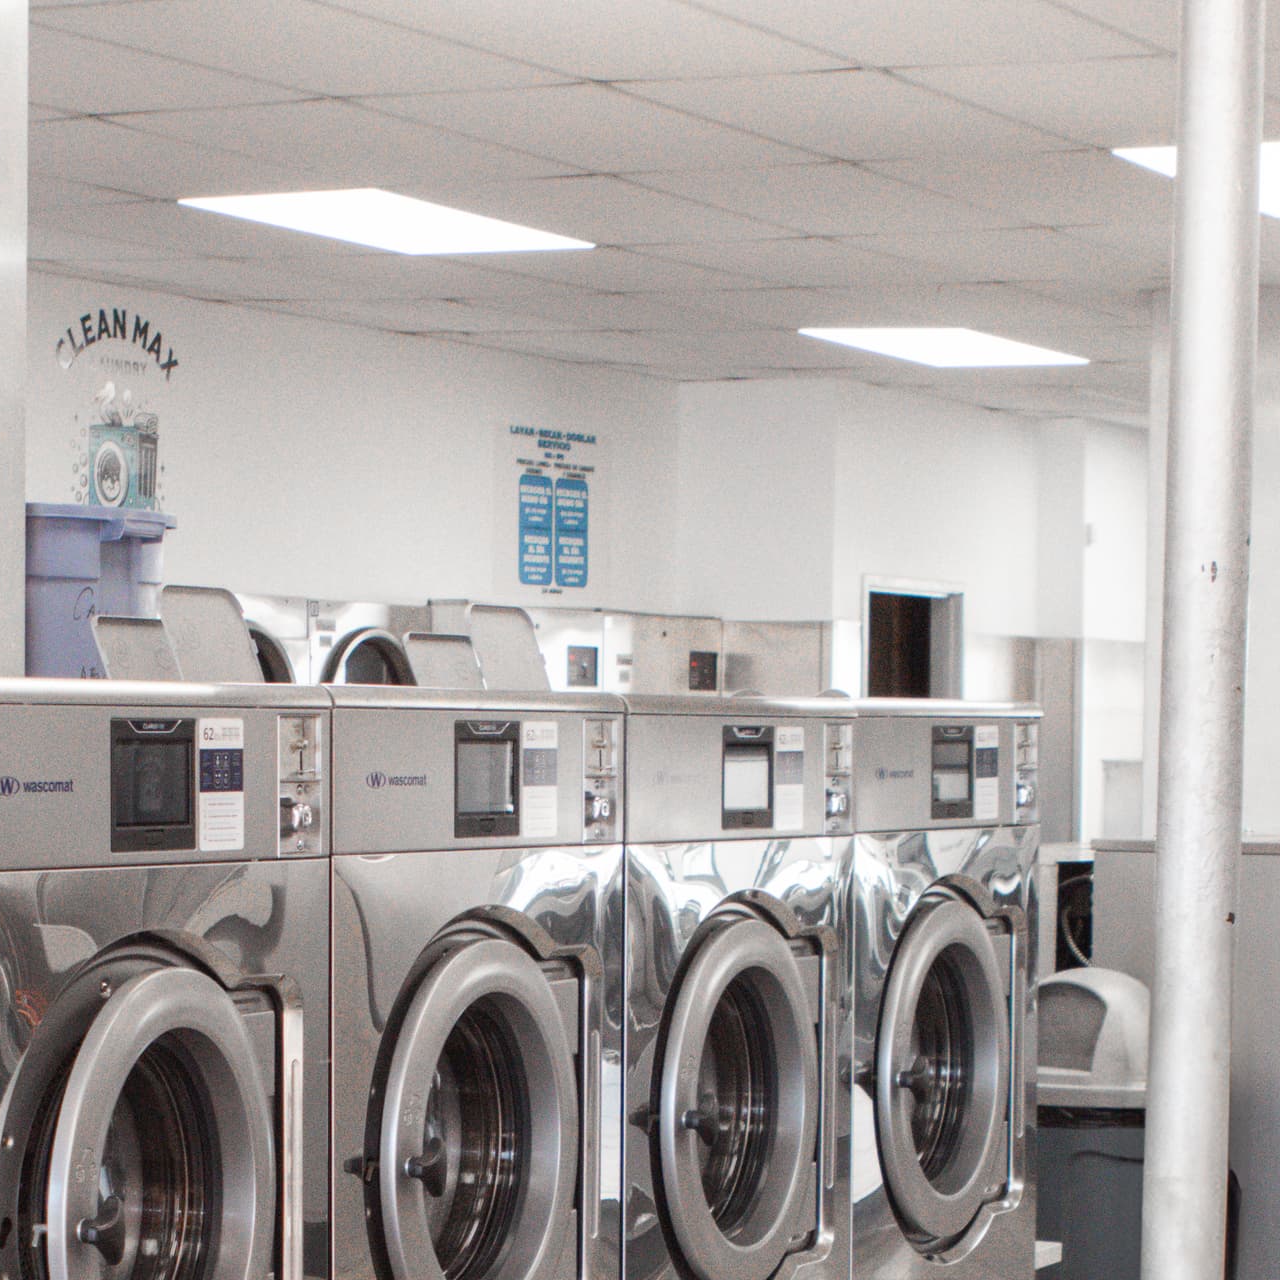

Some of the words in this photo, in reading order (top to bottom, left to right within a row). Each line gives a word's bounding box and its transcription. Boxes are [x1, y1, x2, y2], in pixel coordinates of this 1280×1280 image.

[132, 313, 179, 381] MAX
[203, 727, 215, 741] 62
[23, 779, 74, 793] wascomat
[387, 773, 427, 787] wascomat
